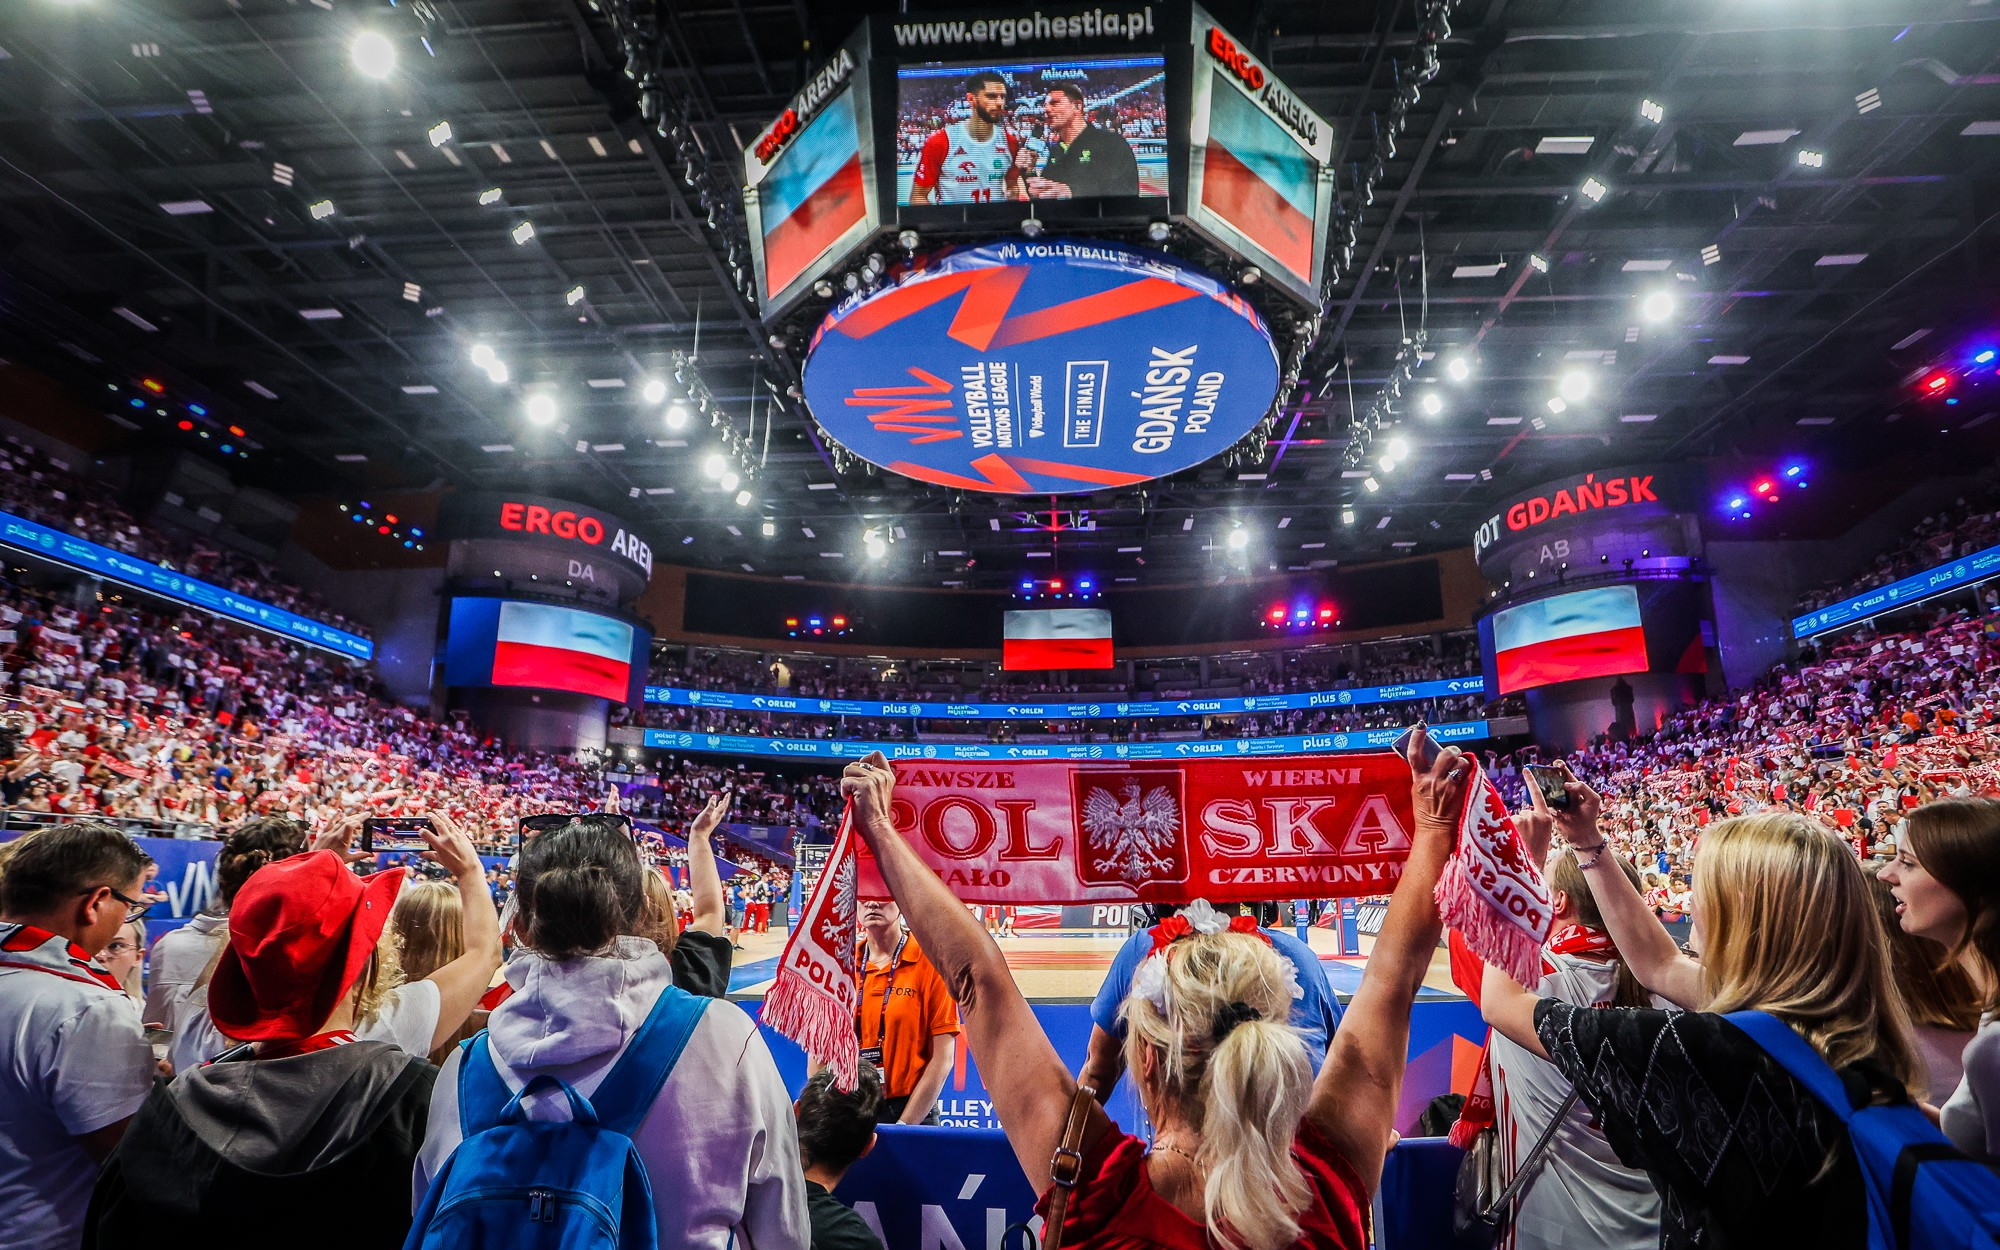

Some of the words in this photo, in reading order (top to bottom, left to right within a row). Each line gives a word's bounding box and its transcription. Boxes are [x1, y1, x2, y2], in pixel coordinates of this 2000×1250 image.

[895, 7, 1154, 46] www.ergohestia.pl
[798, 49, 854, 121] ARENA
[1207, 26, 1264, 90] ERGO
[1262, 81, 1317, 145] ARENA
[971, 188, 991, 203] 11
[1026, 244, 1118, 262] VOLLEYBALL
[989, 362, 1010, 406] LEAGUE
[1030, 375, 1042, 399] World
[1076, 372, 1096, 414] FINALS
[961, 362, 994, 449] VOLLEYBALL
[1131, 344, 1198, 454] GDAŃSK
[1184, 372, 1225, 434] POLAND
[1030, 399, 1046, 429] Volleyball
[997, 408, 1013, 448] NATIONS
[1075, 416, 1091, 440] THE
[500, 502, 605, 545] ERGO
[1474, 514, 1500, 566] POT
[1506, 473, 1659, 531] GDAŃSK
[6, 524, 39, 541] plus
[1540, 539, 1571, 564] AB
[568, 560, 594, 582] DA
[1929, 571, 1953, 587] plus
[1863, 595, 1885, 607] ORLEN
[1463, 680, 1484, 688] ORLE
[768, 700, 796, 708] ORLEN
[883, 704, 907, 715] plus
[1310, 694, 1336, 706] plus
[1368, 731, 1393, 739] BLACHY
[1444, 727, 1475, 737] ORLEN
[787, 743, 817, 752] ORLEN
[894, 745, 921, 757] plus
[1193, 745, 1223, 753] ORLEN
[1303, 737, 1331, 750] plus
[894, 770, 1016, 789] ZAWSZE
[1242, 768, 1364, 787] WIERNI
[1200, 795, 1413, 858] SKA
